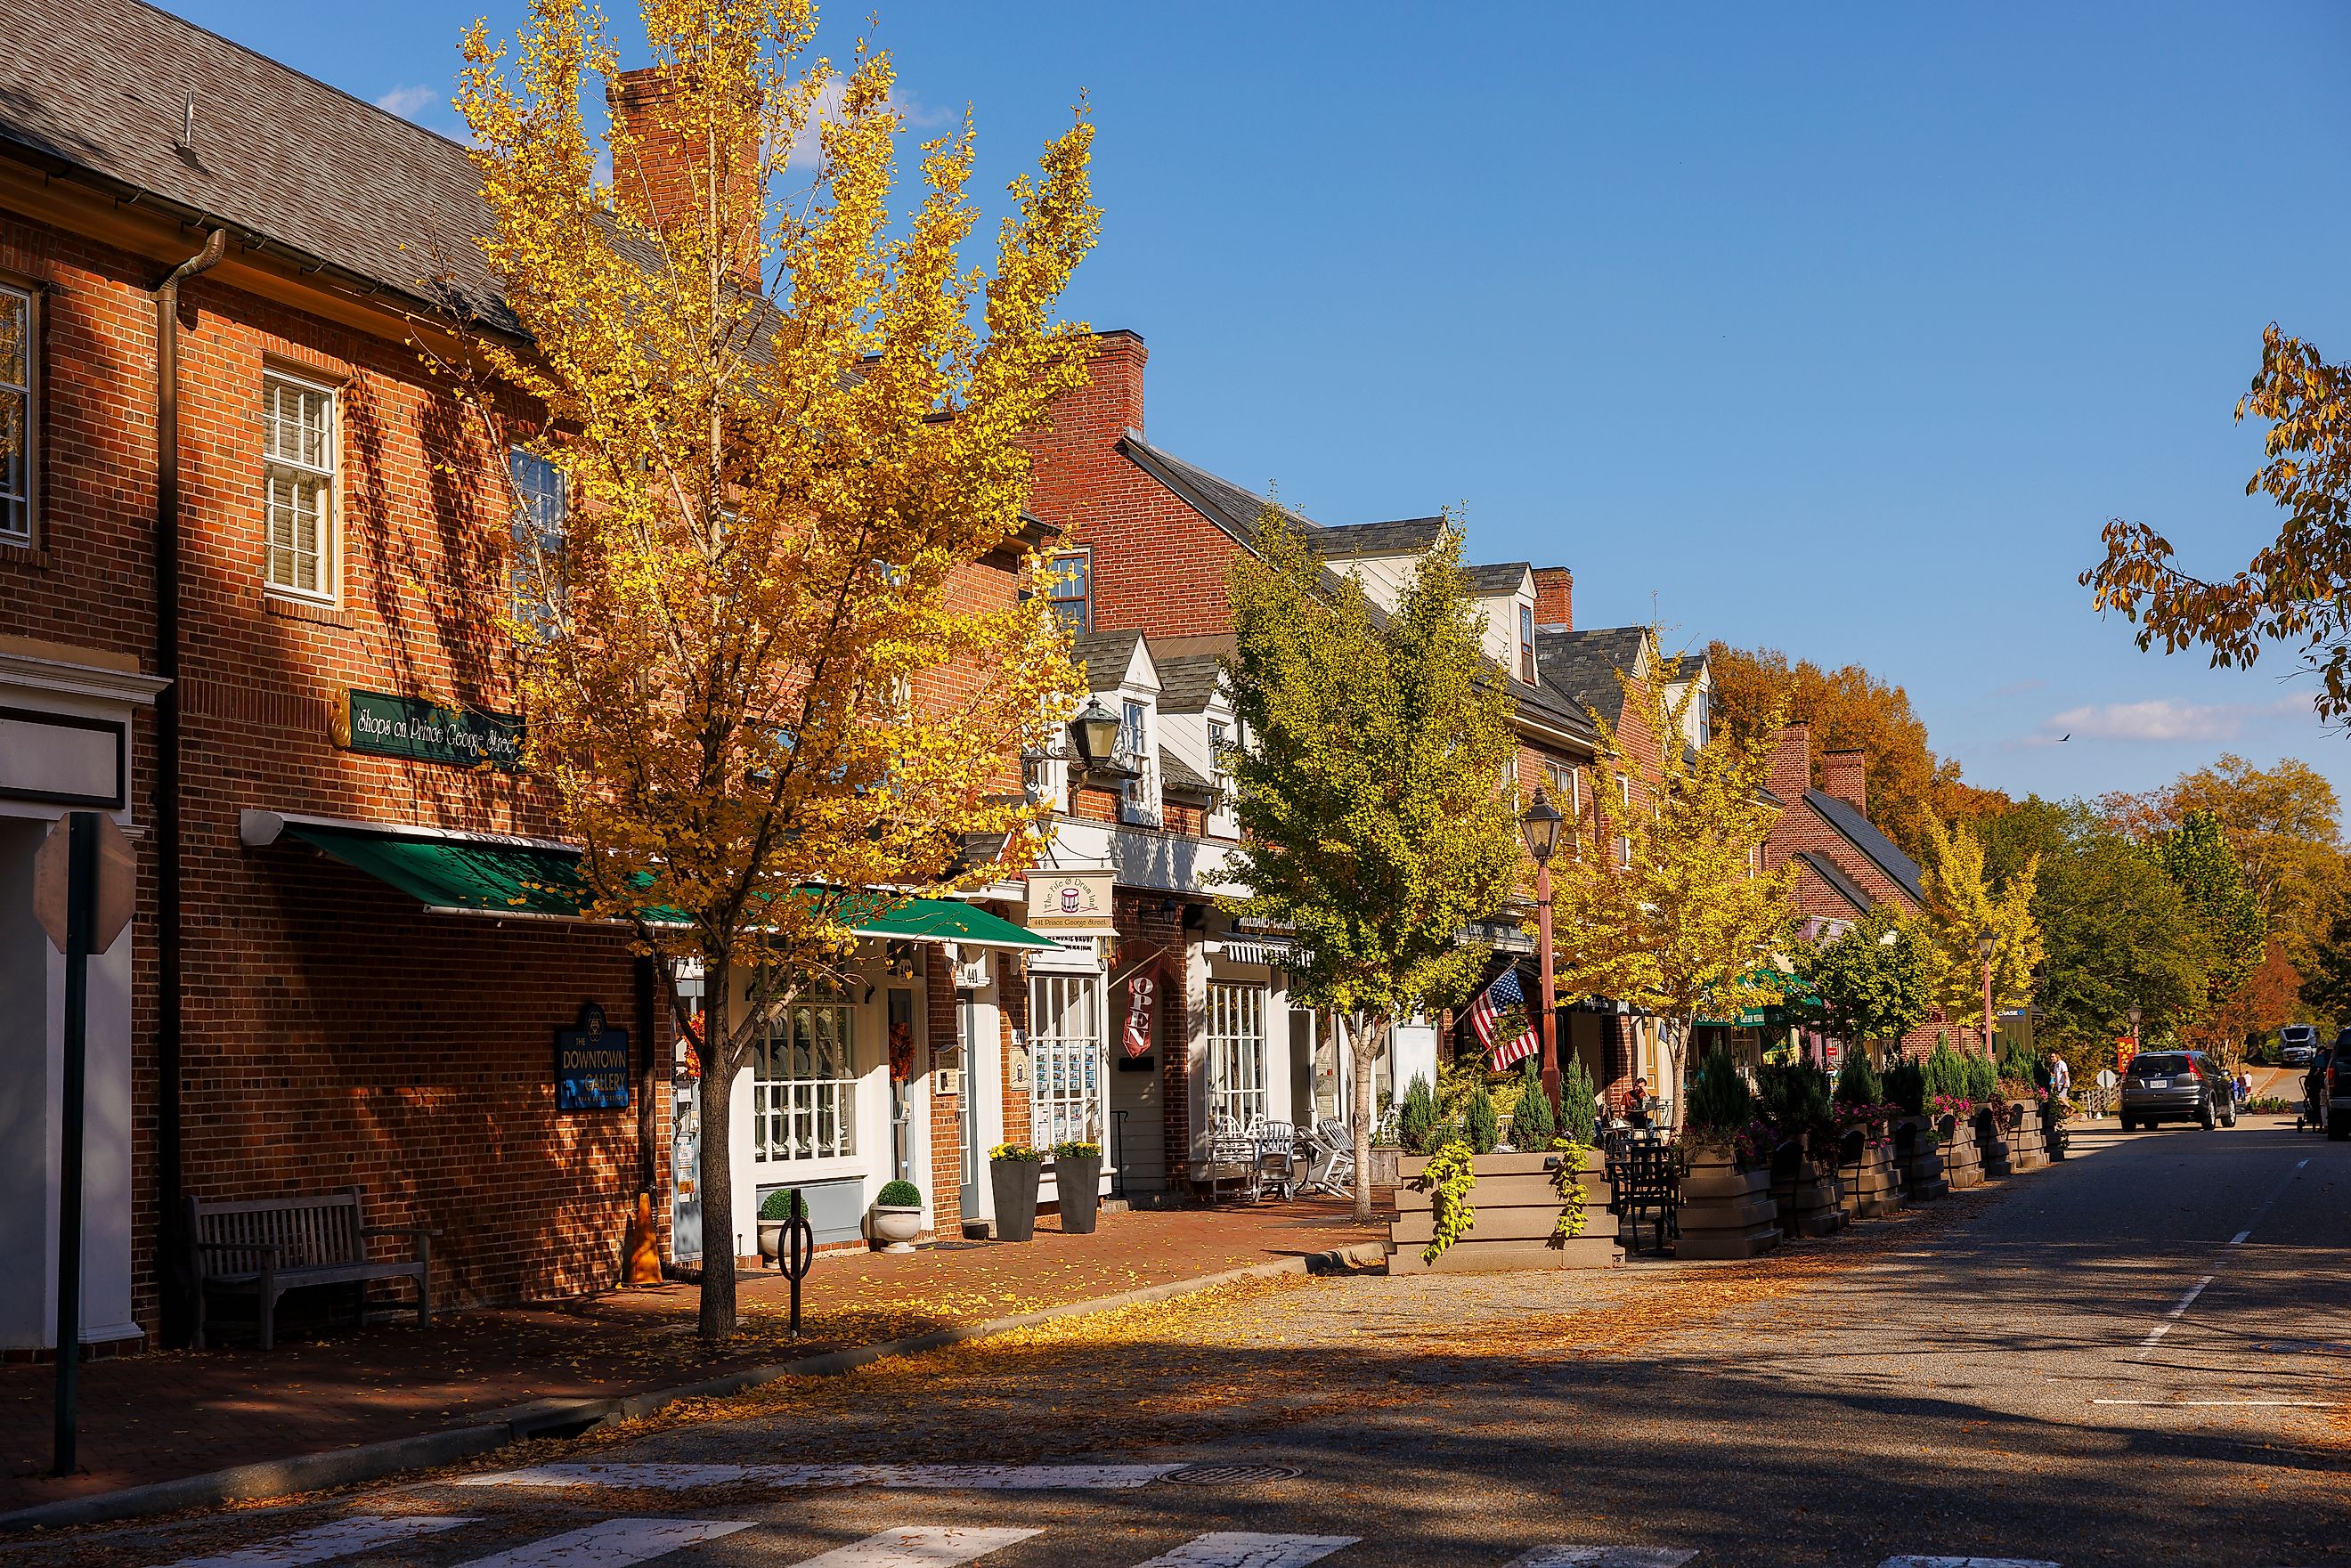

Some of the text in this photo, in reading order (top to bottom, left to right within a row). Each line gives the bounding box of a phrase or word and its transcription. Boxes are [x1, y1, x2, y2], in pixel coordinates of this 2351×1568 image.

[357, 709, 518, 757] Shops on Prince George Street
[1044, 877, 1096, 909] The Fife & Drum Inn
[1064, 919, 1086, 928] George
[966, 968, 979, 984] 441
[1127, 977, 1154, 1046] OPEN
[575, 1037, 586, 1046] THE
[563, 1051, 626, 1068] DOWNTOWN
[585, 1073, 626, 1092] GALLERY
